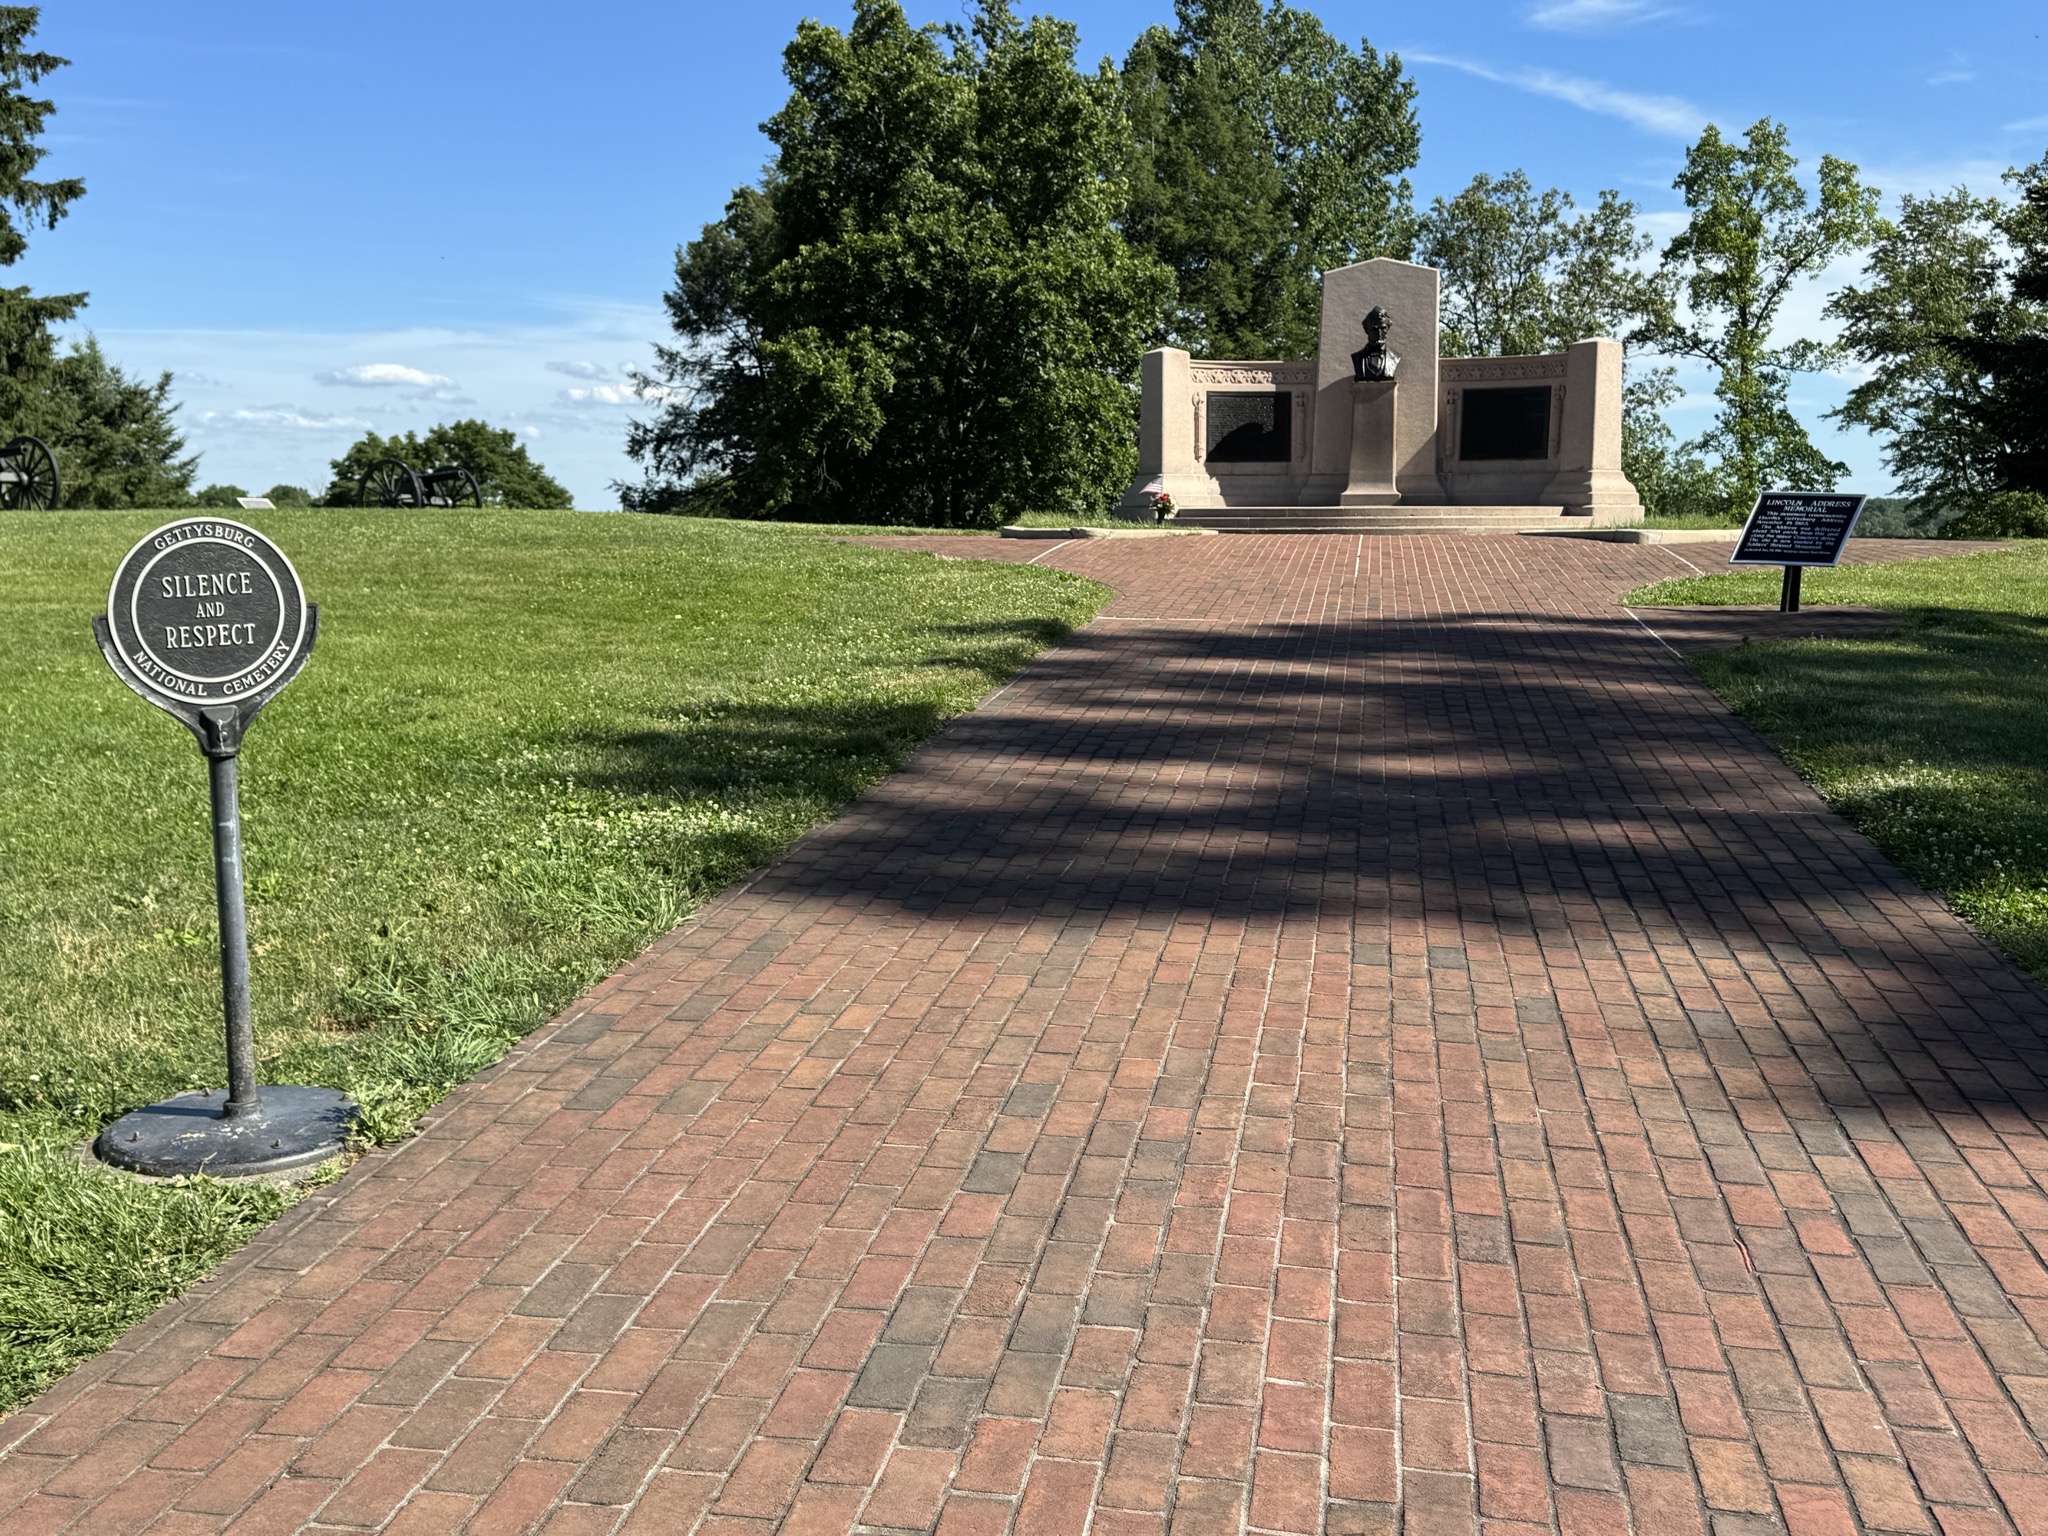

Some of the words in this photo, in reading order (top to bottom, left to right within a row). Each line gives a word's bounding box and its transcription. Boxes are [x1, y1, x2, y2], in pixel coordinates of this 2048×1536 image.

[154, 524, 255, 550] GETTYSBURG
[161, 572, 253, 598] SILENCE
[196, 602, 225, 618] AND
[165, 623, 256, 649] RESPECT
[132, 650, 207, 696] NATIONAL
[222, 639, 291, 696] CEMETERY
